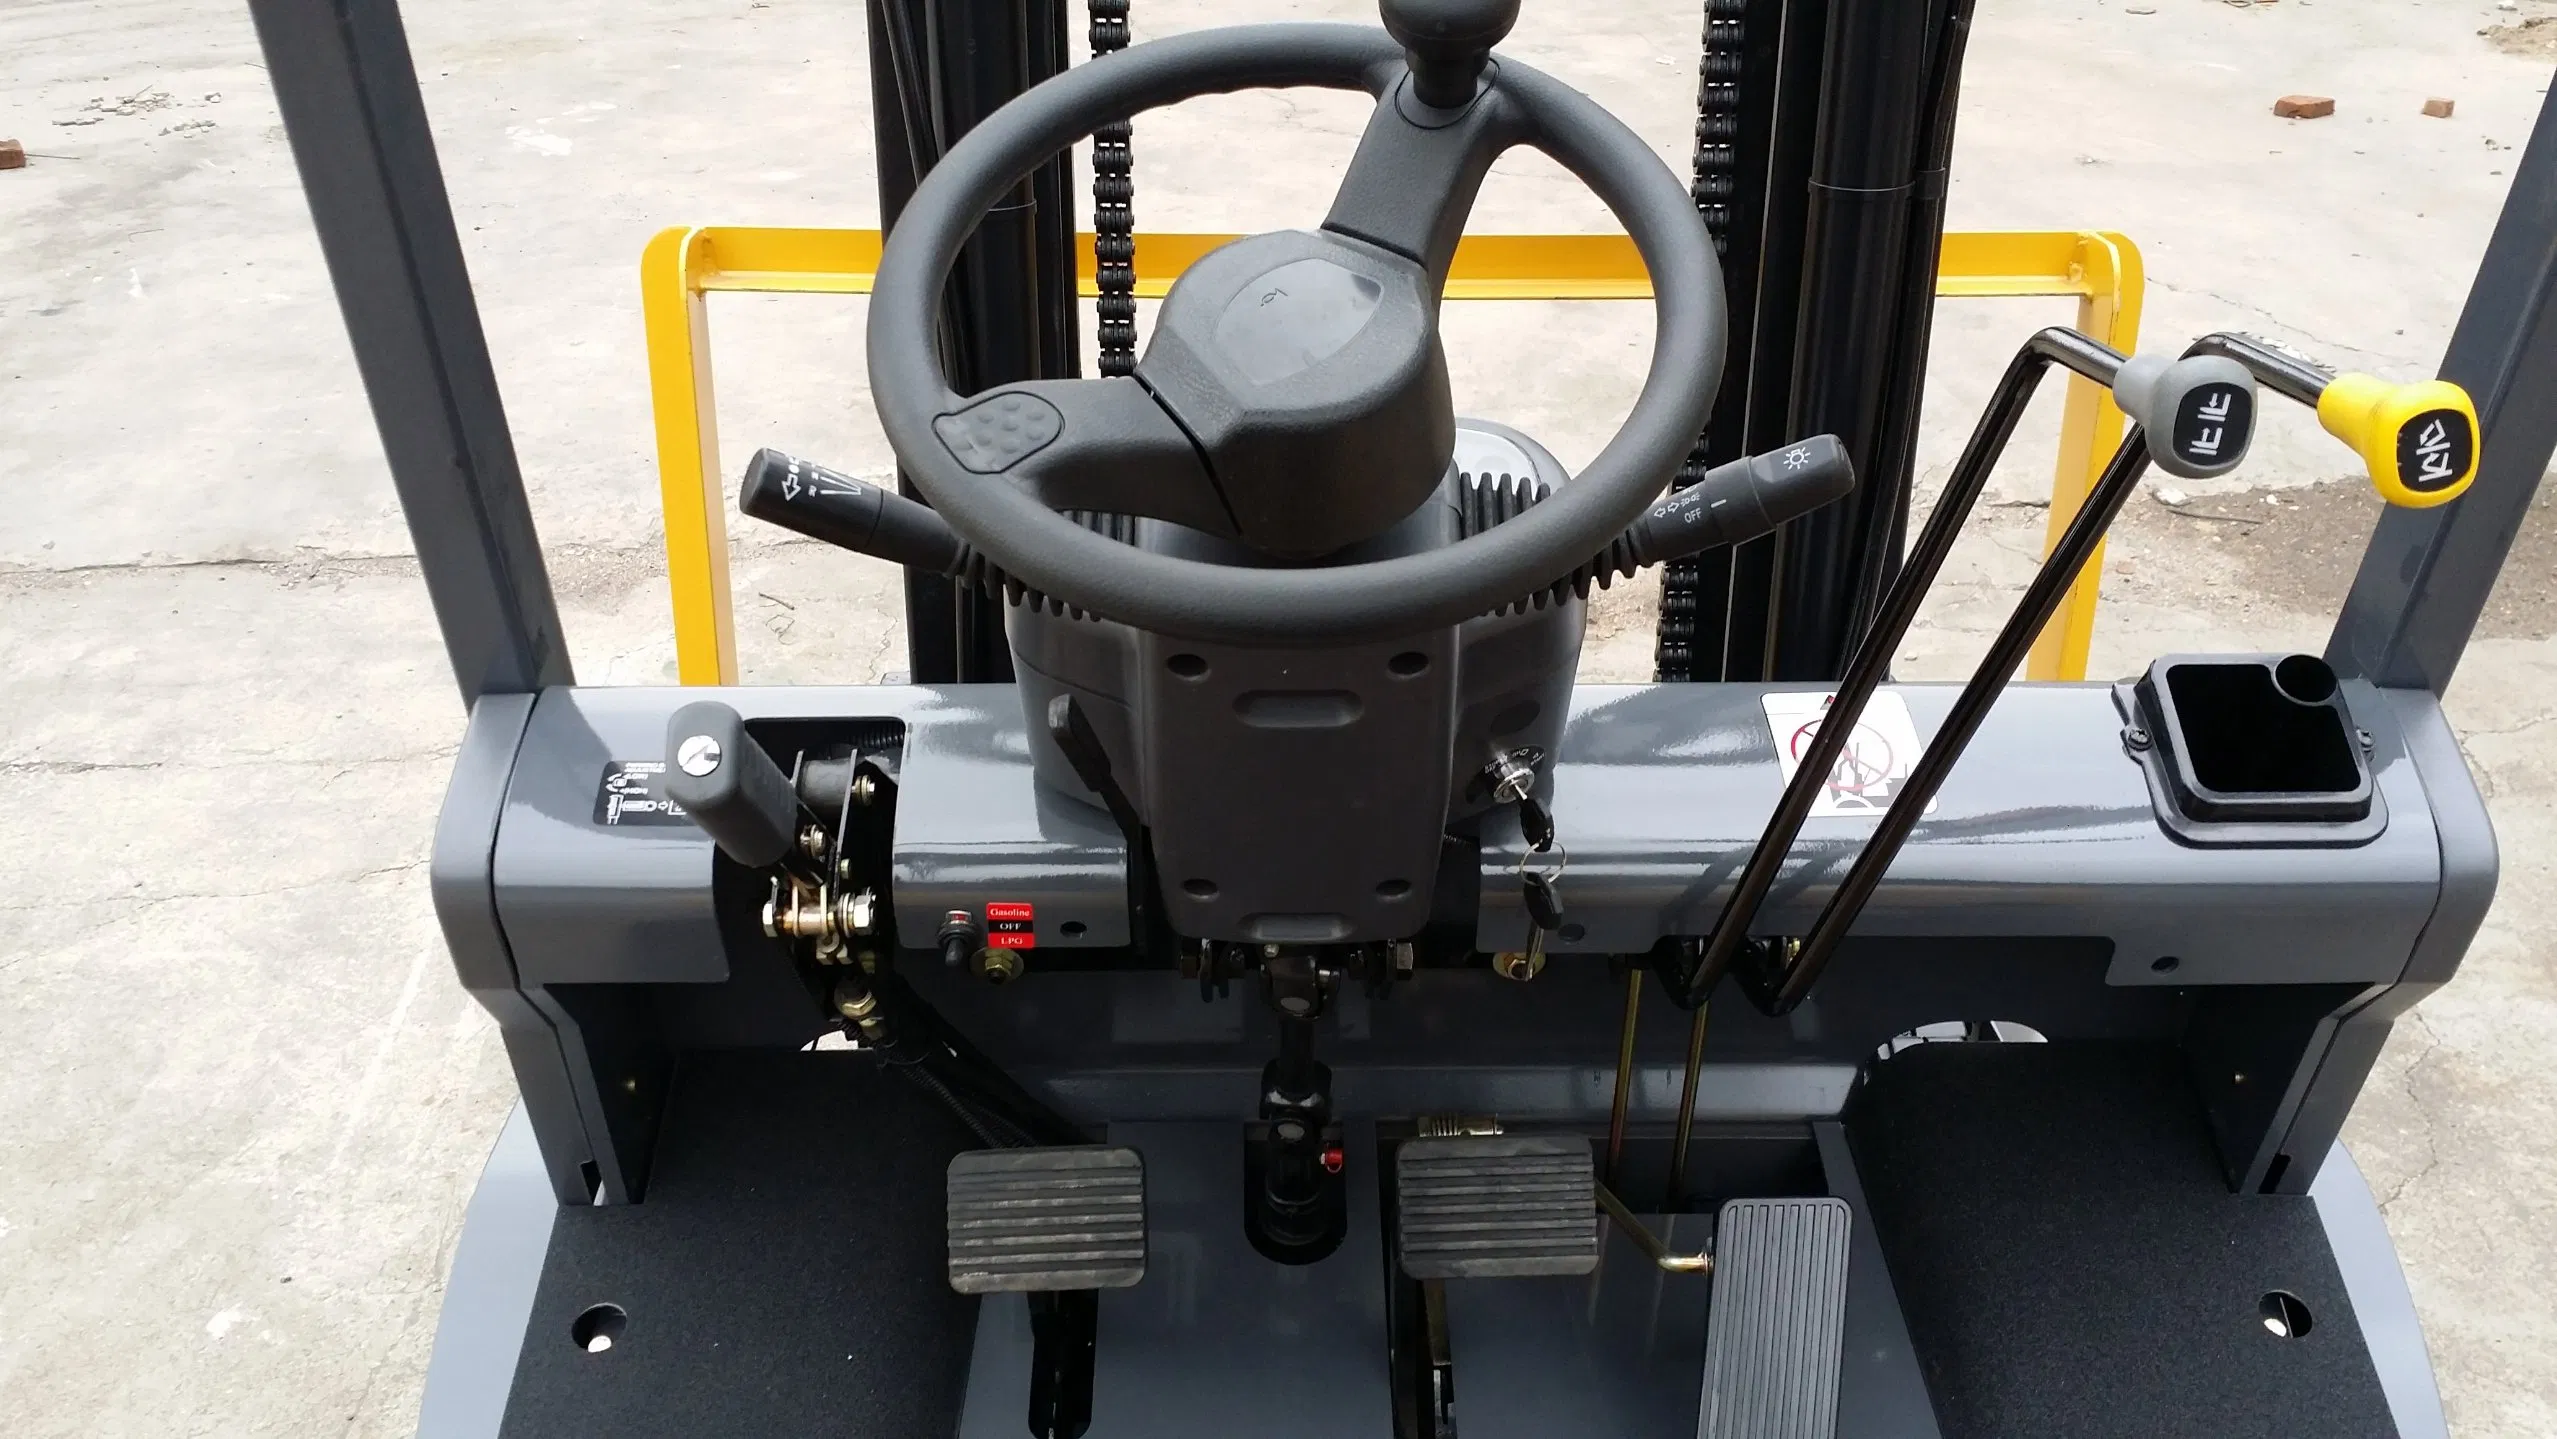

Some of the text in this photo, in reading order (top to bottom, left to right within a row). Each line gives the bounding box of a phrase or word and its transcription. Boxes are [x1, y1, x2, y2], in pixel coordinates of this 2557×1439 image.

[1685, 507, 1701, 523] OFF
[989, 907, 1030, 917] Gasoline
[999, 922, 1021, 931] OFF
[1001, 936, 1023, 945] LPG
